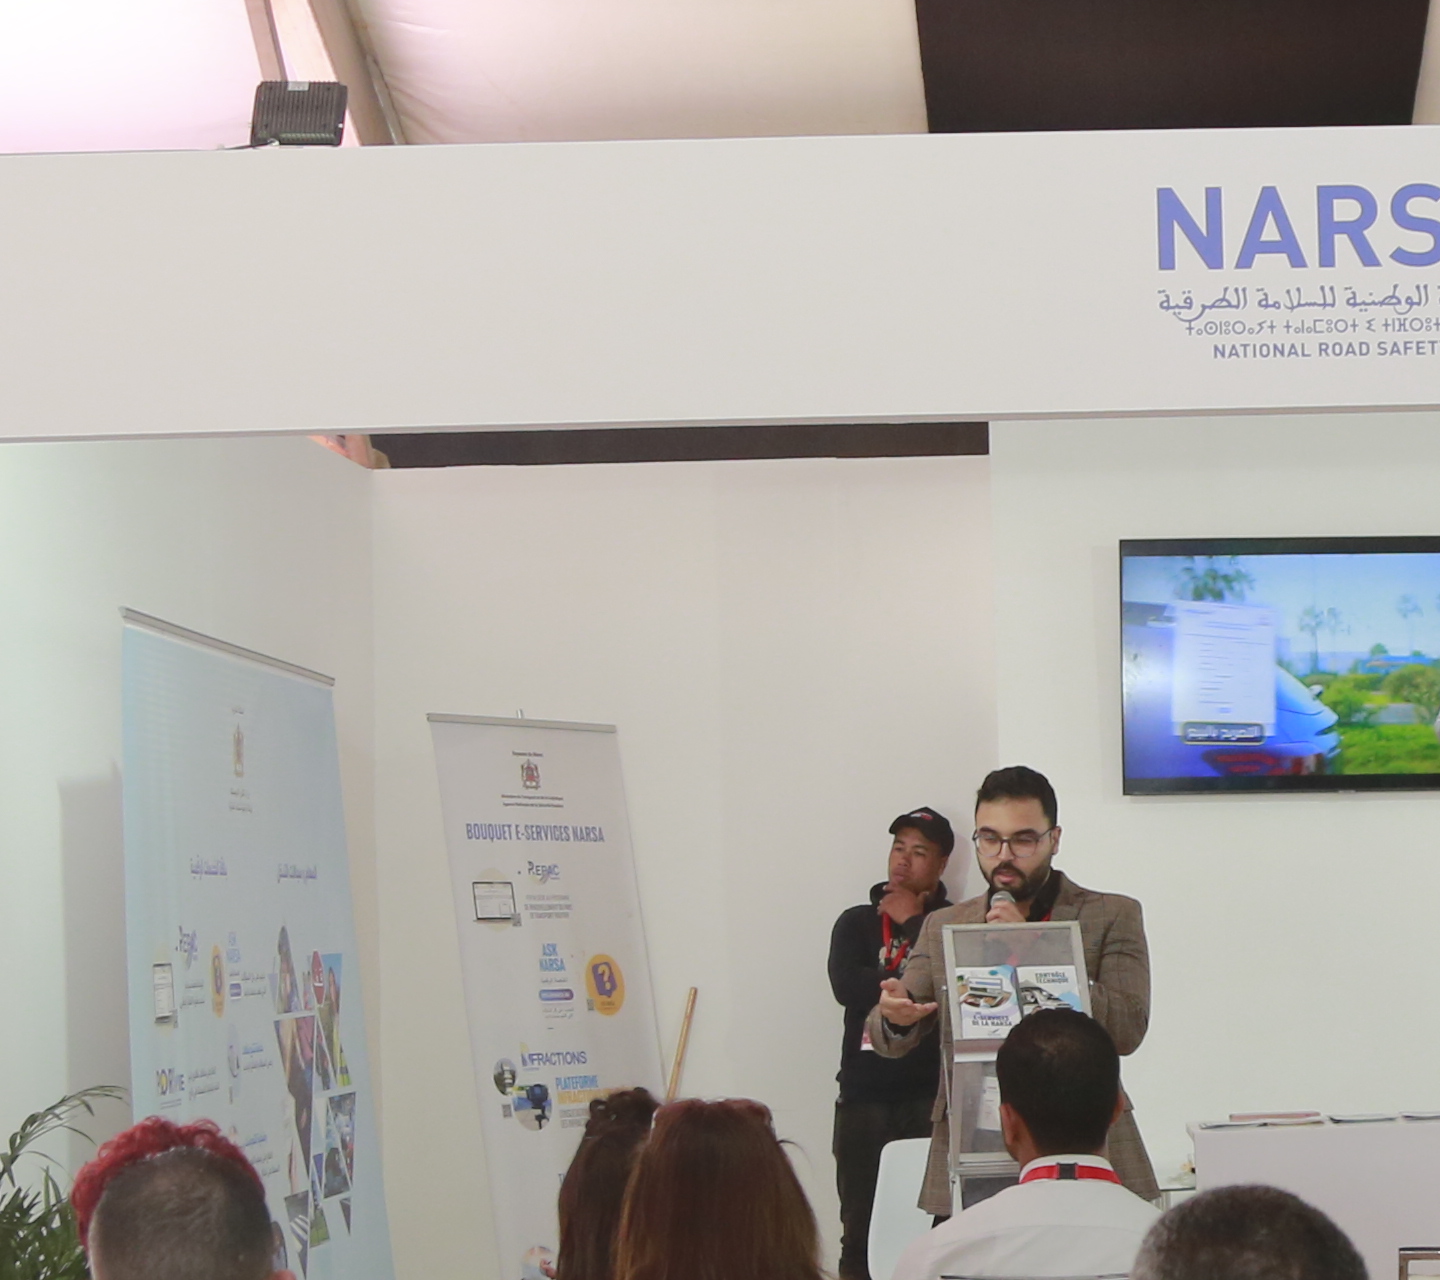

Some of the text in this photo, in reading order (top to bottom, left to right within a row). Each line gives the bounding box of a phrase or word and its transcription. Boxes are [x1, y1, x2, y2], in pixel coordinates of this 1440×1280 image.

[1157, 285, 1248, 322] الطرقية
[1256, 285, 1336, 313] للسلامة
[1344, 283, 1429, 315] الوطنية
[1213, 342, 1311, 359] NATIONAL
[1318, 341, 1370, 357] ROAD
[466, 823, 605, 843] BOUQUET E-SERVICES NARSA
[542, 943, 558, 957] ASK
[539, 958, 566, 972] NARSA
[556, 1074, 599, 1090] PLATEFORME
